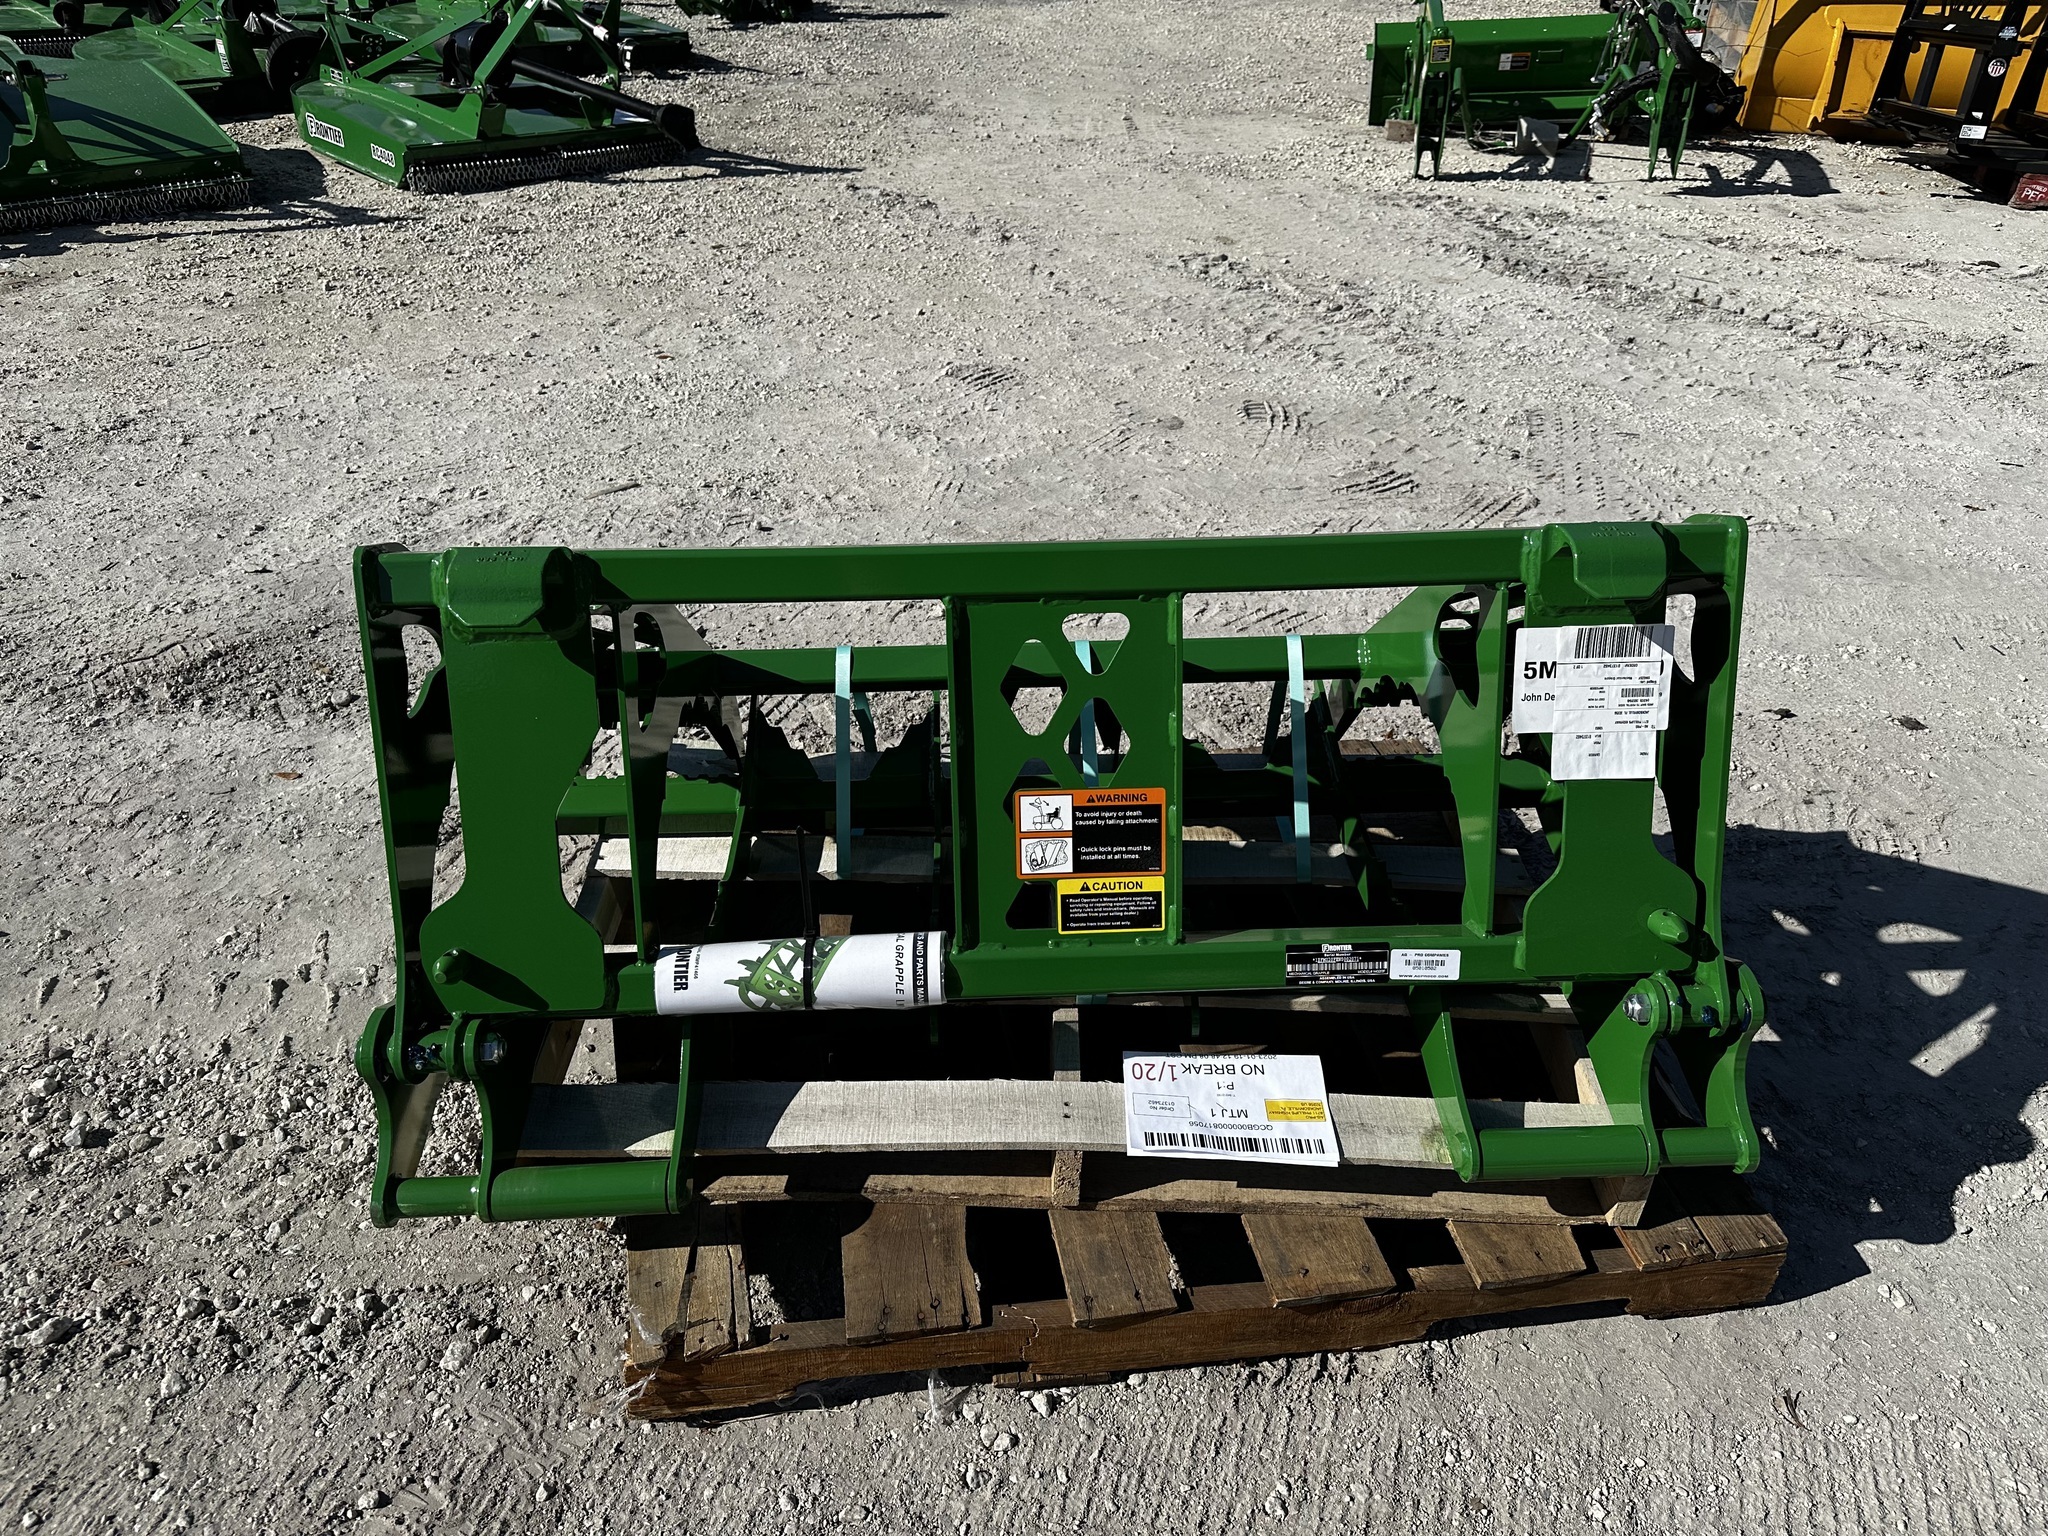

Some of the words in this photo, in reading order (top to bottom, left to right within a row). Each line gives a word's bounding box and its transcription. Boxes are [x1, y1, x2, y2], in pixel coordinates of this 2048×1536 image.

[307, 113, 343, 146] FRONTIER
[1521, 693, 1542, 702] John
[1544, 693, 1556, 702] De
[1096, 793, 1148, 803] WARNING
[1092, 881, 1143, 891] CAUTION
[916, 940, 924, 956] AND
[1322, 944, 1352, 952] FRONTIER
[895, 944, 904, 995] GRAPPLE
[916, 958, 924, 986] PARTS
[1132, 1061, 1178, 1082] 1/20
[1182, 1062, 1236, 1075] BREAK
[1241, 1064, 1264, 1075] NO
[1216, 1081, 1234, 1090] P:1
[1210, 1108, 1215, 1118] 1
[1221, 1108, 1248, 1119] MTJ
